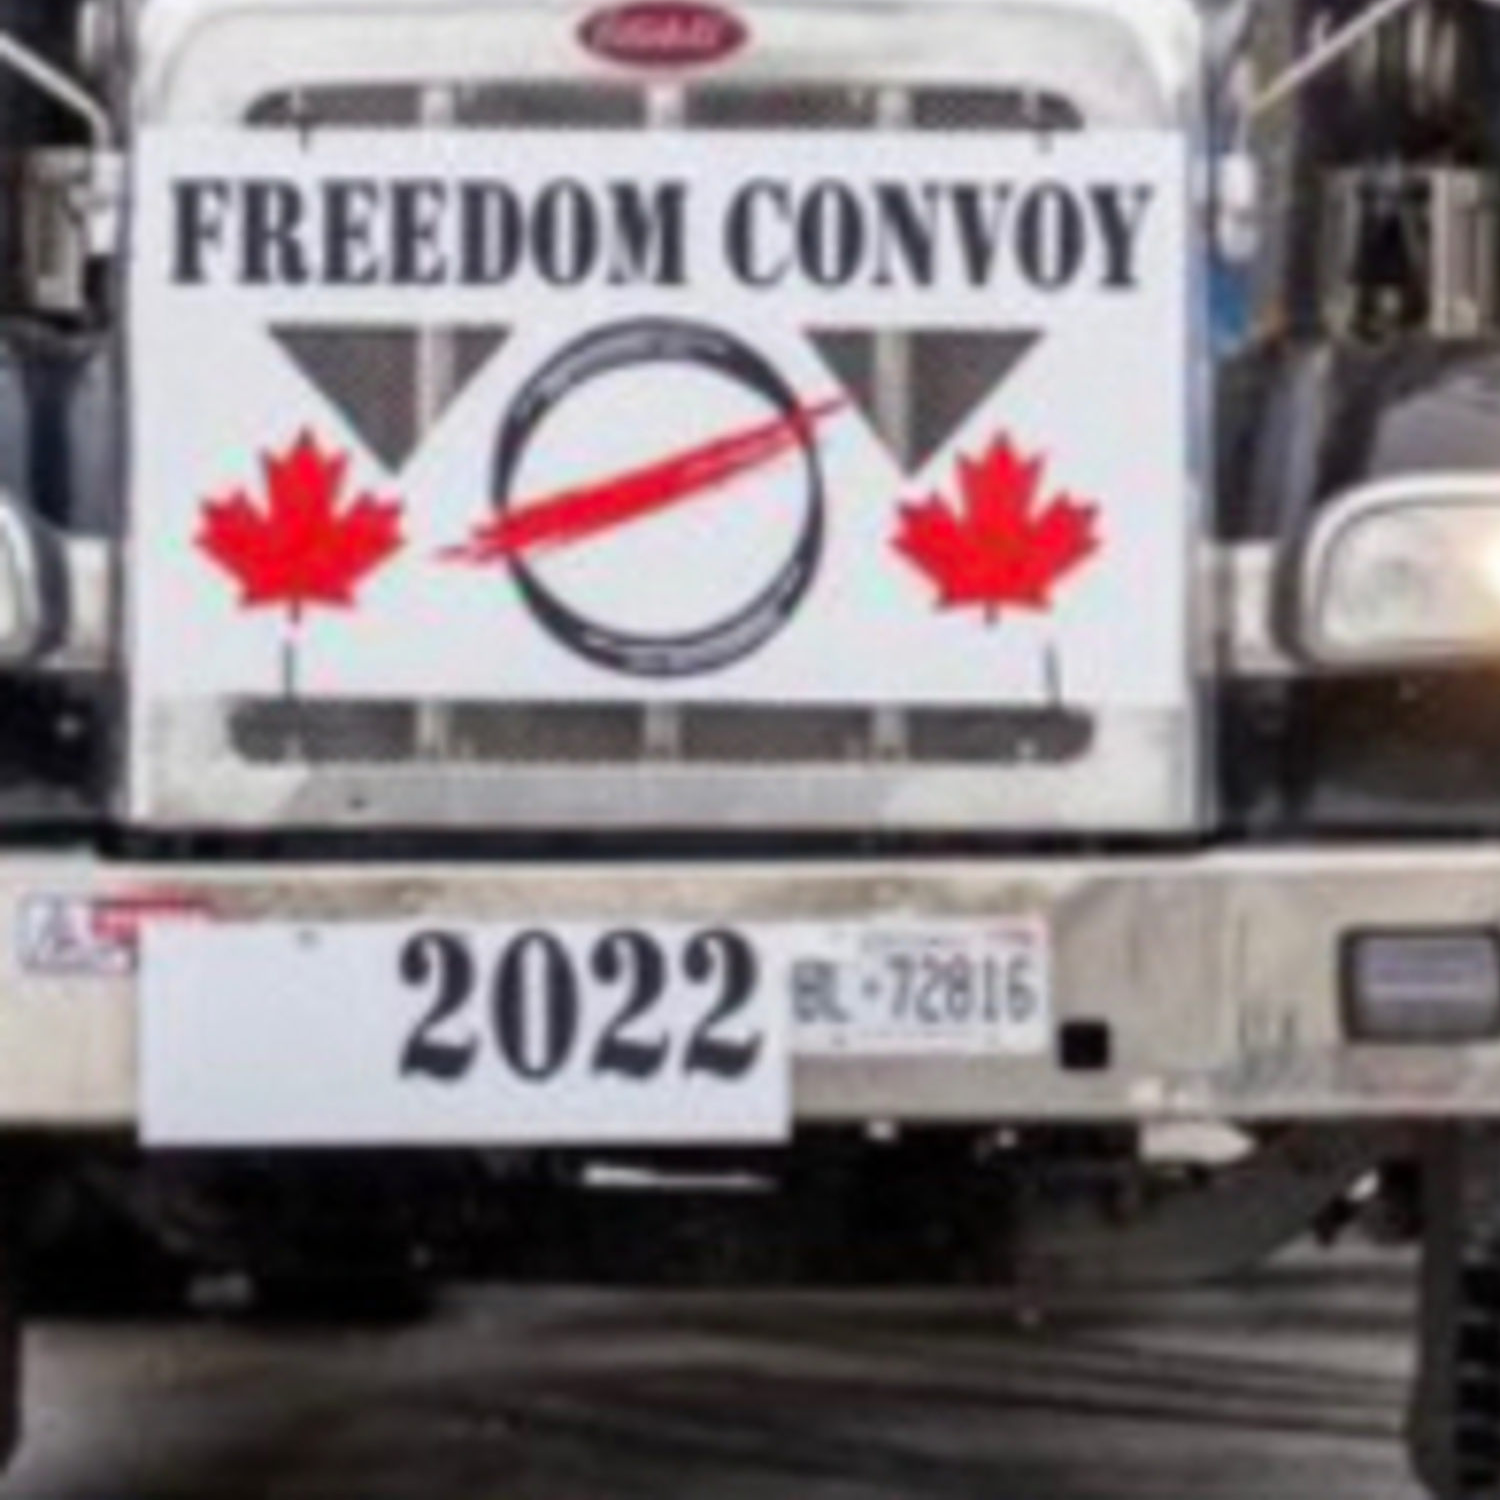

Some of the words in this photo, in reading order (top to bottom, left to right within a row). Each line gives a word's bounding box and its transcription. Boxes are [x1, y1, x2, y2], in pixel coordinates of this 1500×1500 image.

[172, 179, 687, 287] FREEDOM
[723, 181, 1151, 289] CONVOY
[397, 928, 763, 1083] 2022
